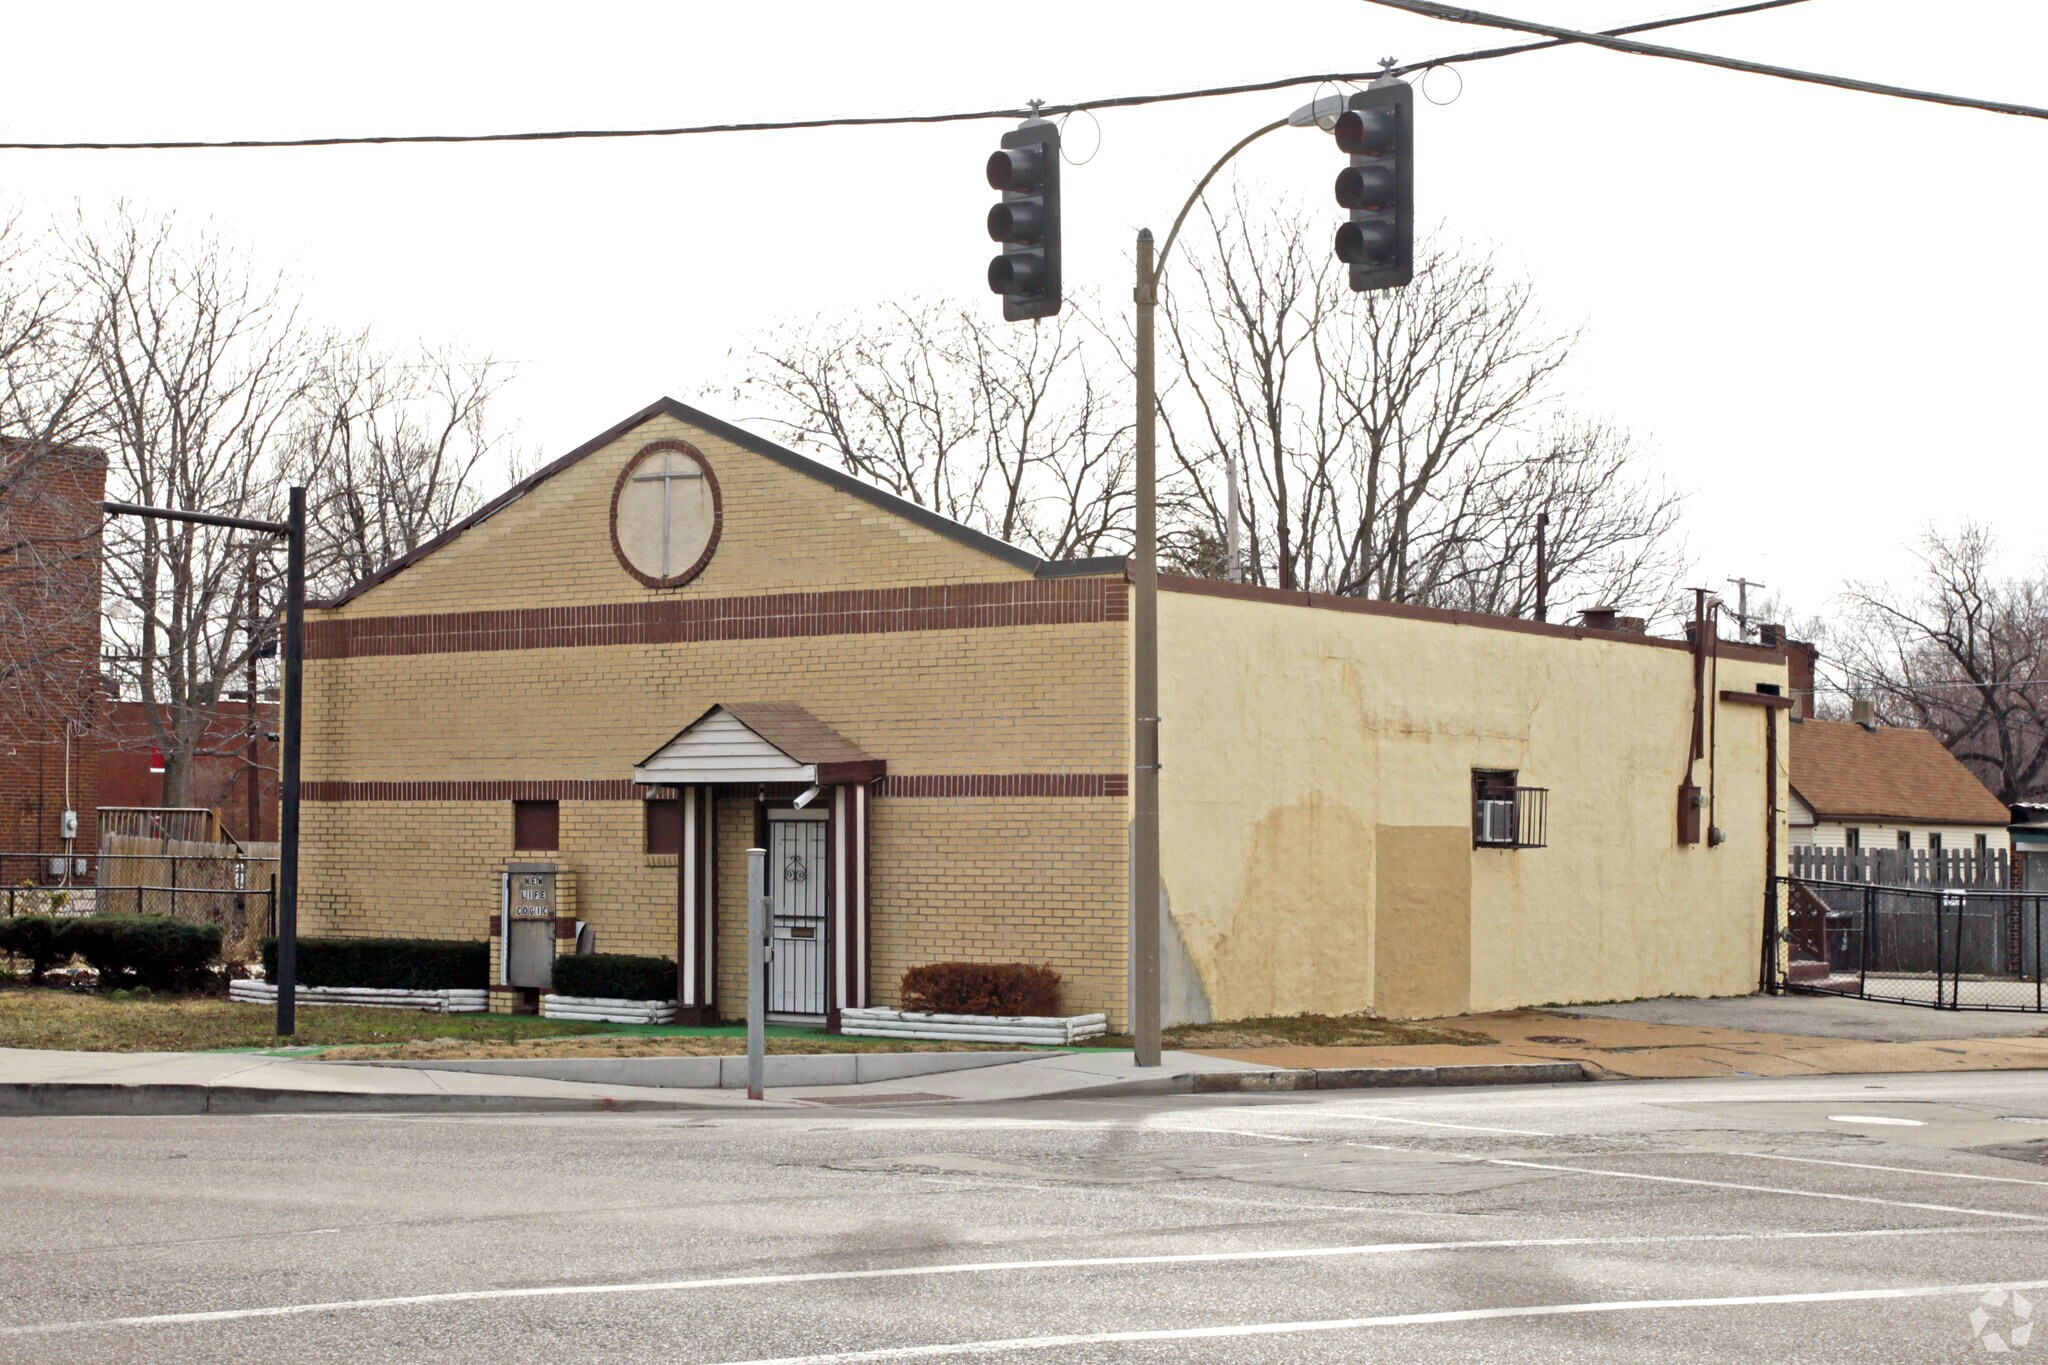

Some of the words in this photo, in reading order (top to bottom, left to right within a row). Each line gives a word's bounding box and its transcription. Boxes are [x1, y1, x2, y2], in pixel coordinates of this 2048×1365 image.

[524, 876, 544, 886] NEW
[521, 890, 546, 900] LIFE
[516, 906, 548, 916] COGIC
